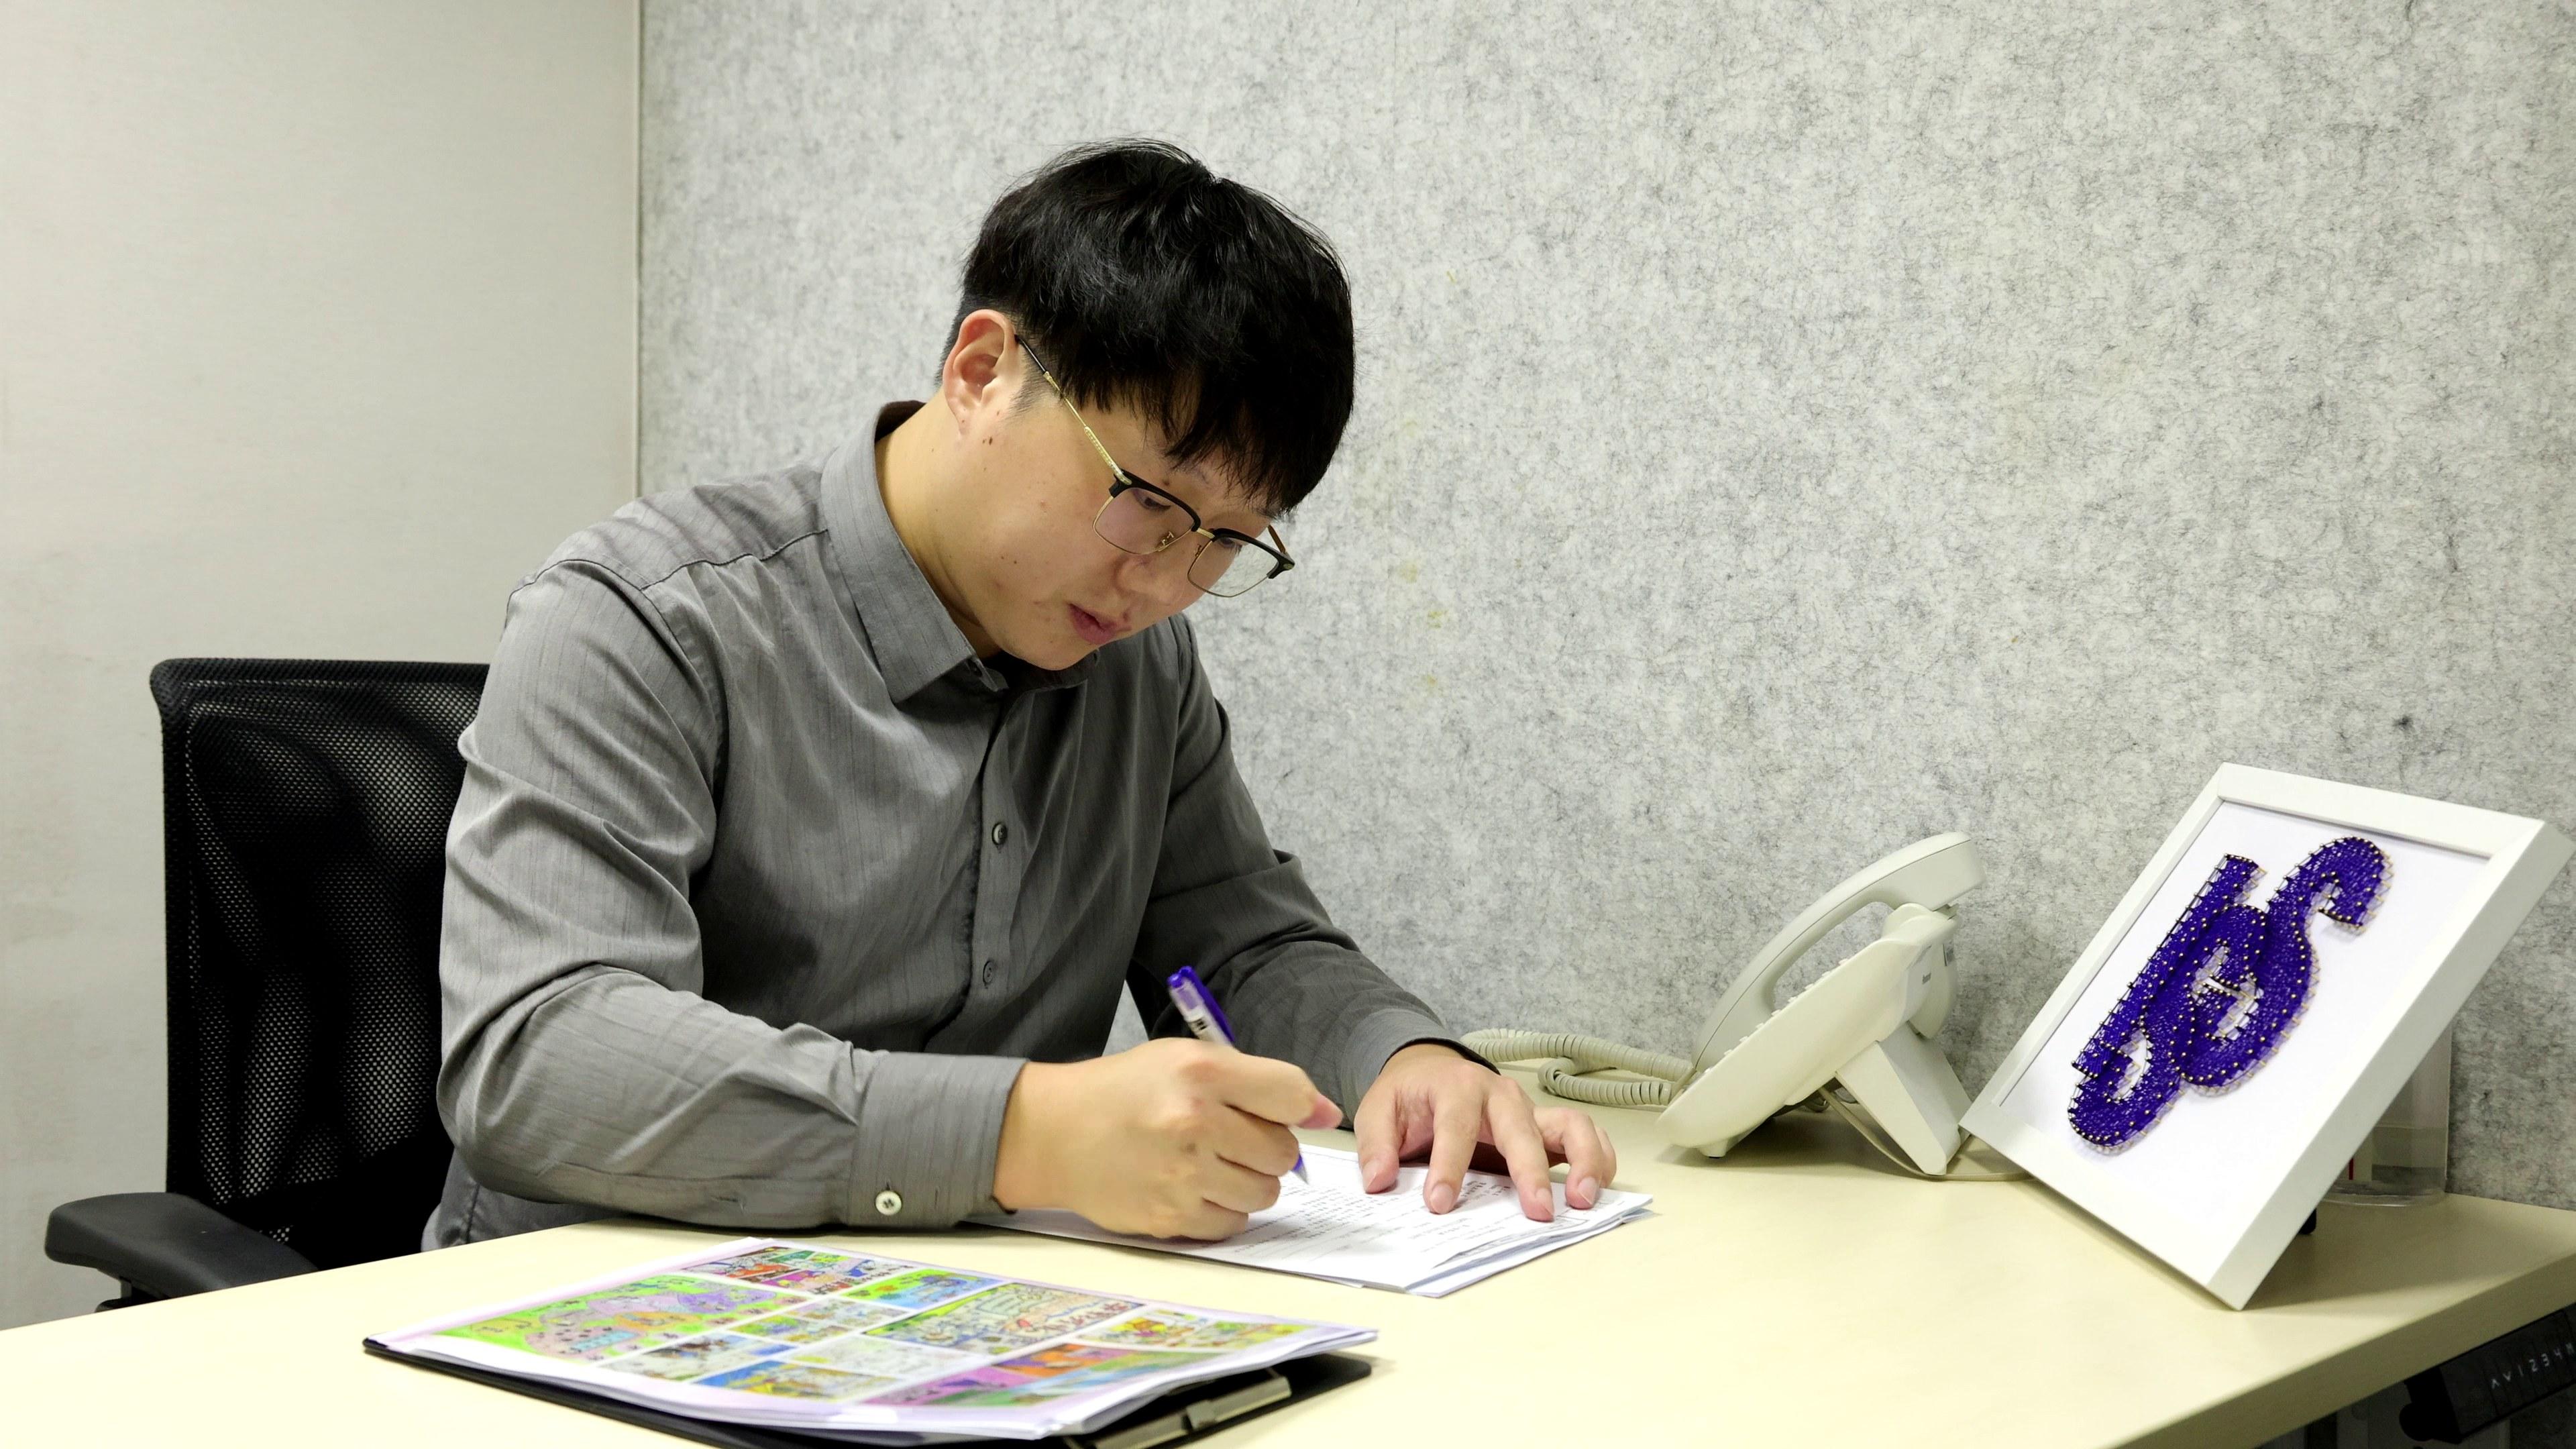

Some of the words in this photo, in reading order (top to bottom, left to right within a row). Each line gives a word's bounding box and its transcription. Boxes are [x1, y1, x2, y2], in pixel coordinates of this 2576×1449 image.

[2529, 1359, 2537, 1372] 2
[2541, 1353, 2549, 1366] 3
[2554, 1347, 2563, 1360] 4
